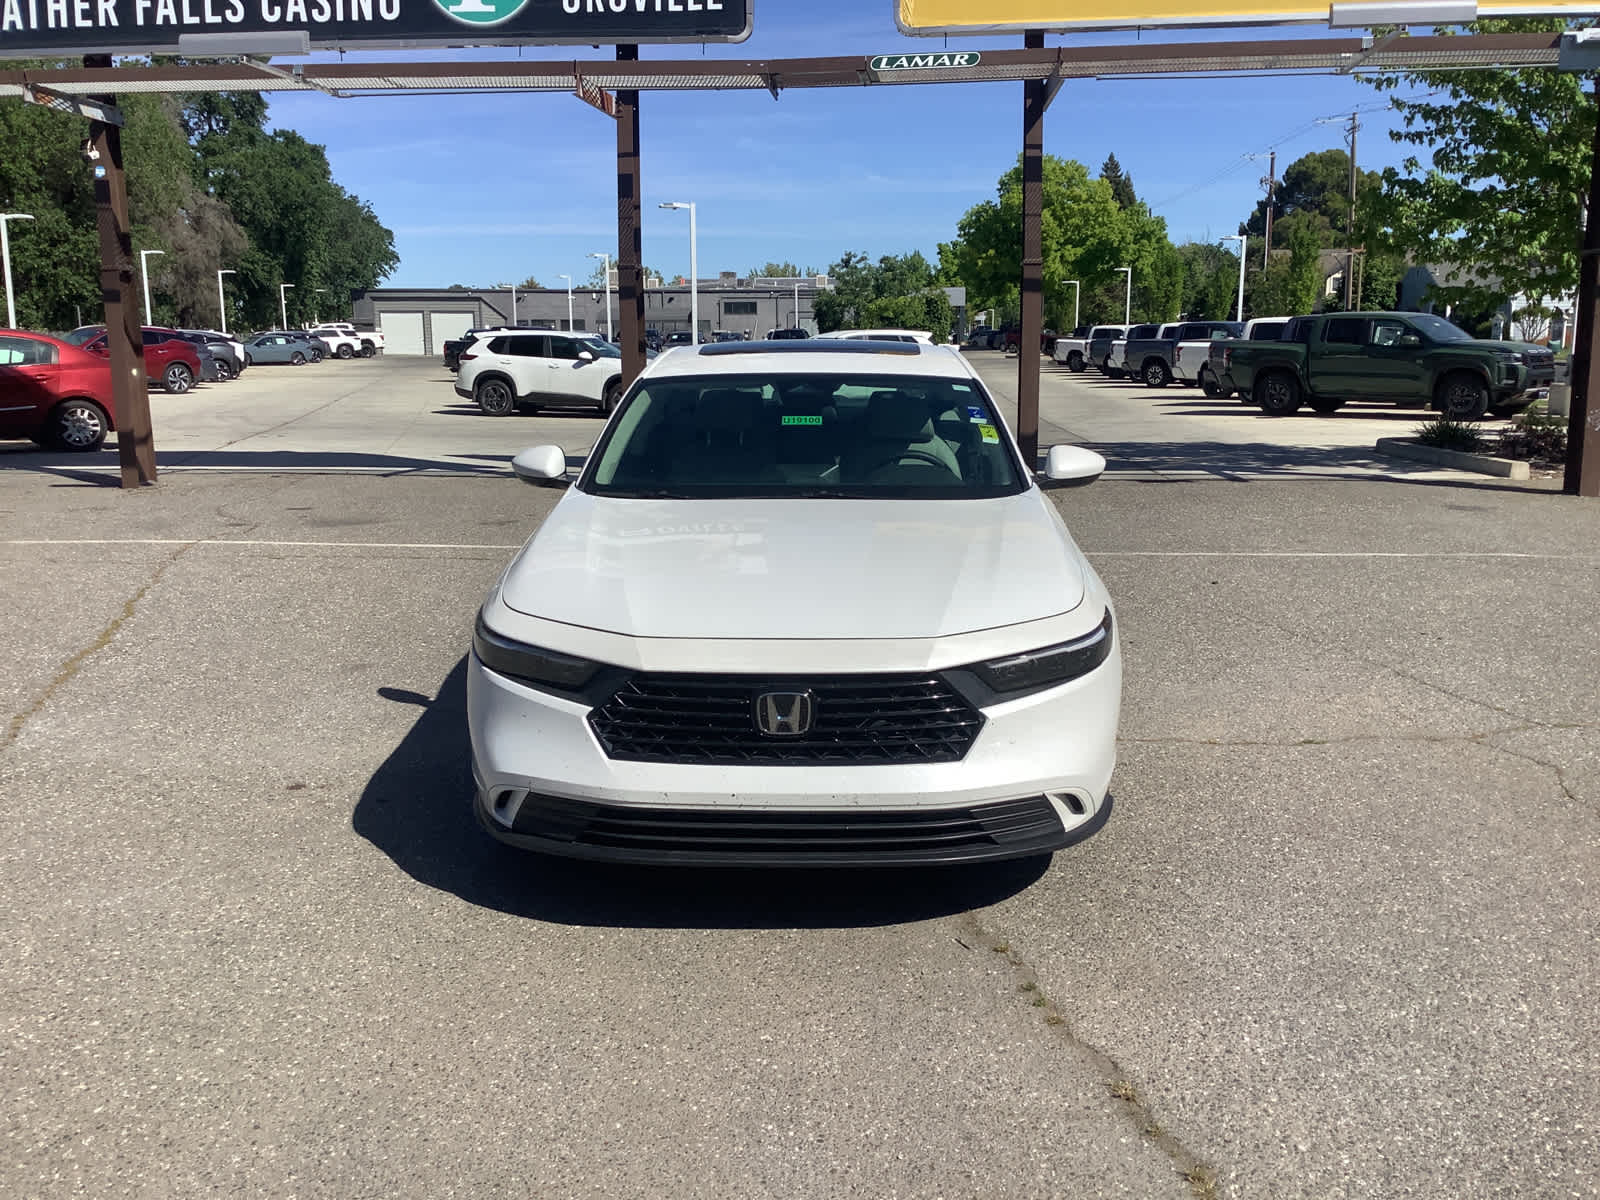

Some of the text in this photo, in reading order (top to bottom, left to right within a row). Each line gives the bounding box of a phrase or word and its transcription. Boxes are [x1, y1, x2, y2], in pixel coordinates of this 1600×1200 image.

[135, 0, 245, 26] FALLS
[261, 0, 401, 23] CASINO
[879, 54, 970, 69] LAMAR
